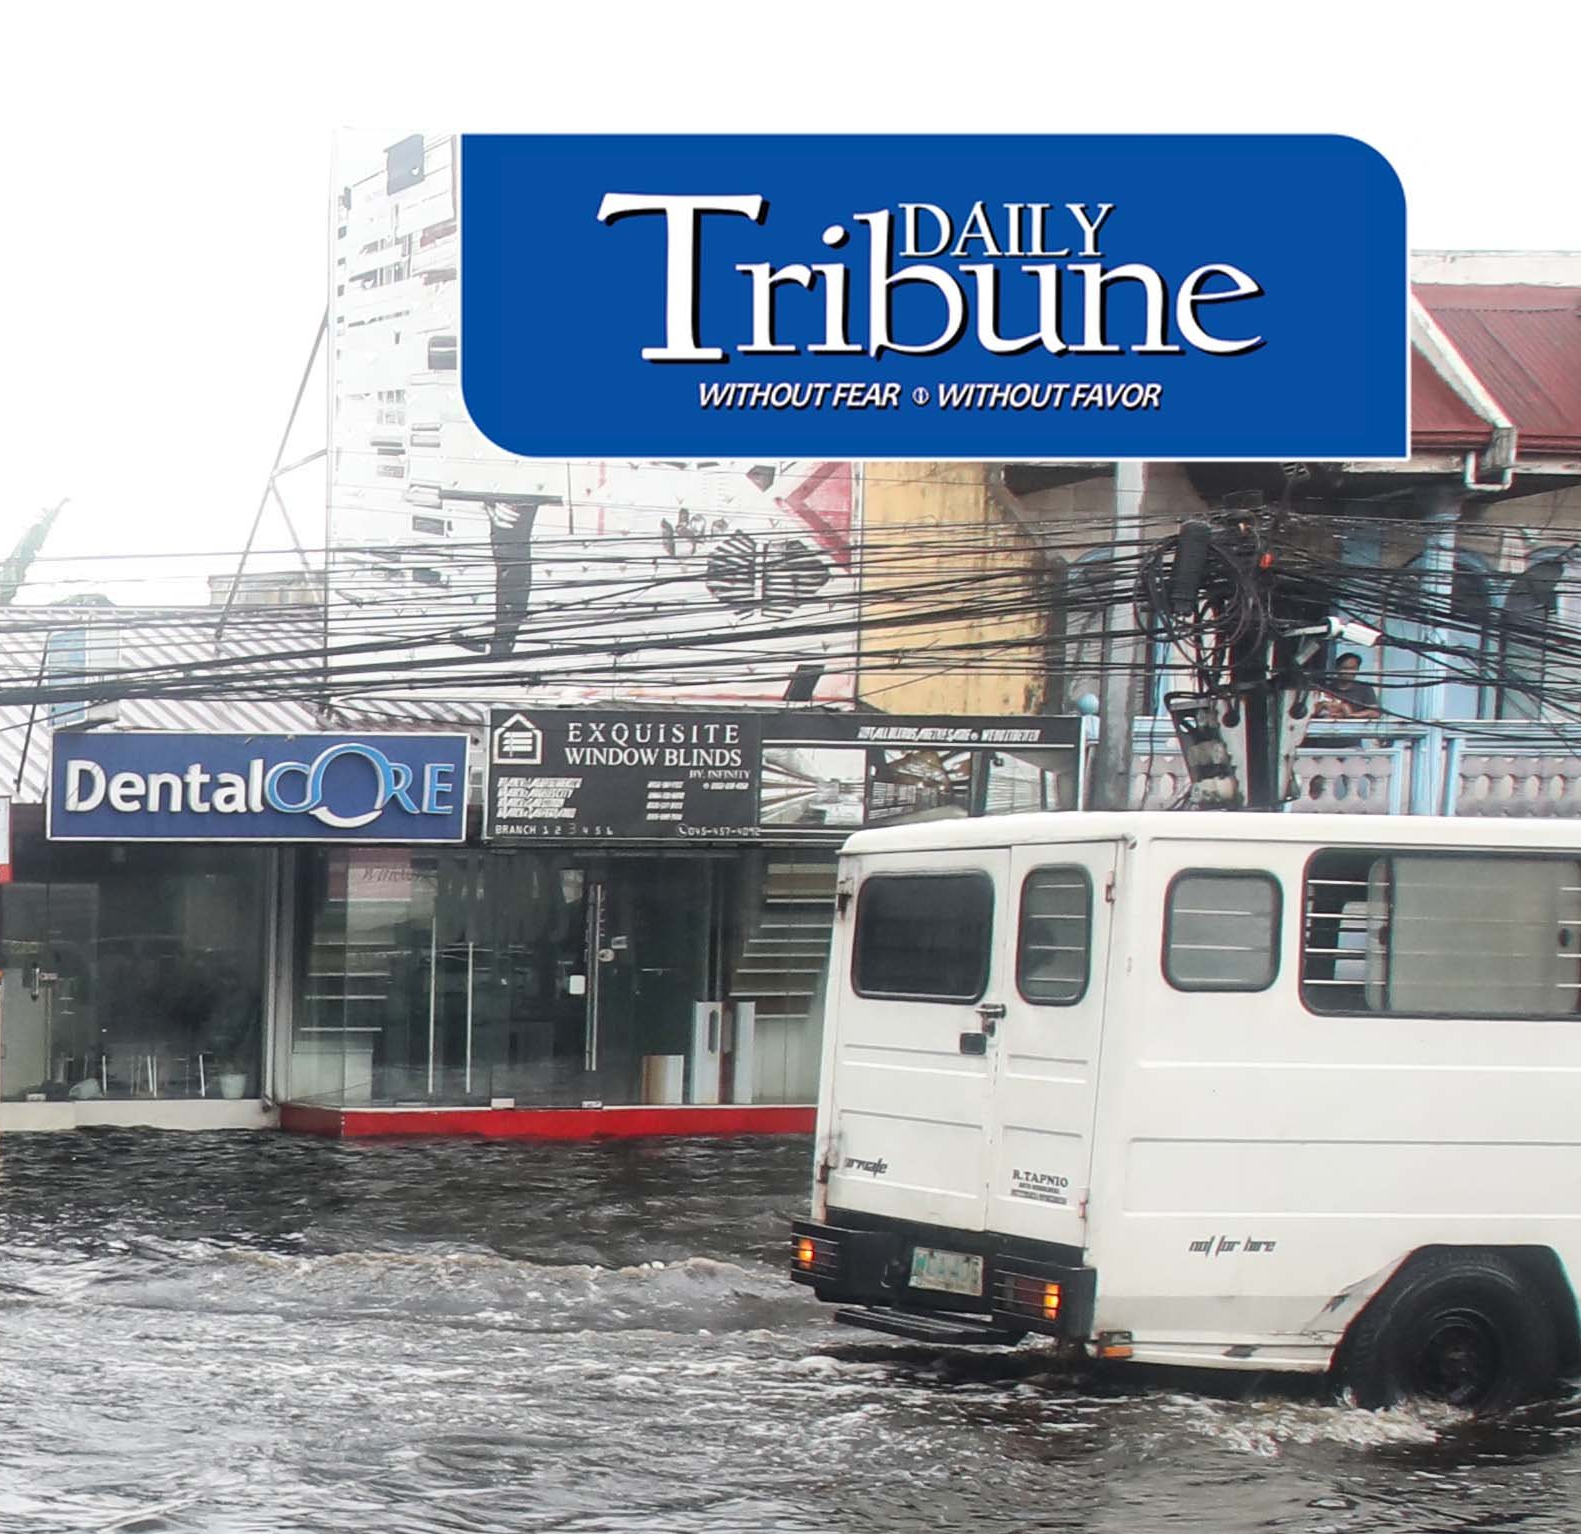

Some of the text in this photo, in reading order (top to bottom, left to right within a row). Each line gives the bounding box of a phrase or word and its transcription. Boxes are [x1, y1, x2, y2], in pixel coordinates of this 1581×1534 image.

[568, 722, 740, 747] EXQUISITE
[565, 747, 742, 767] WINDOW BLINDS
[707, 769, 751, 779] INFINITY
[495, 825, 536, 835] BRANCH
[555, 826, 562, 835] 2
[1188, 1235, 1277, 1257] not for hire
